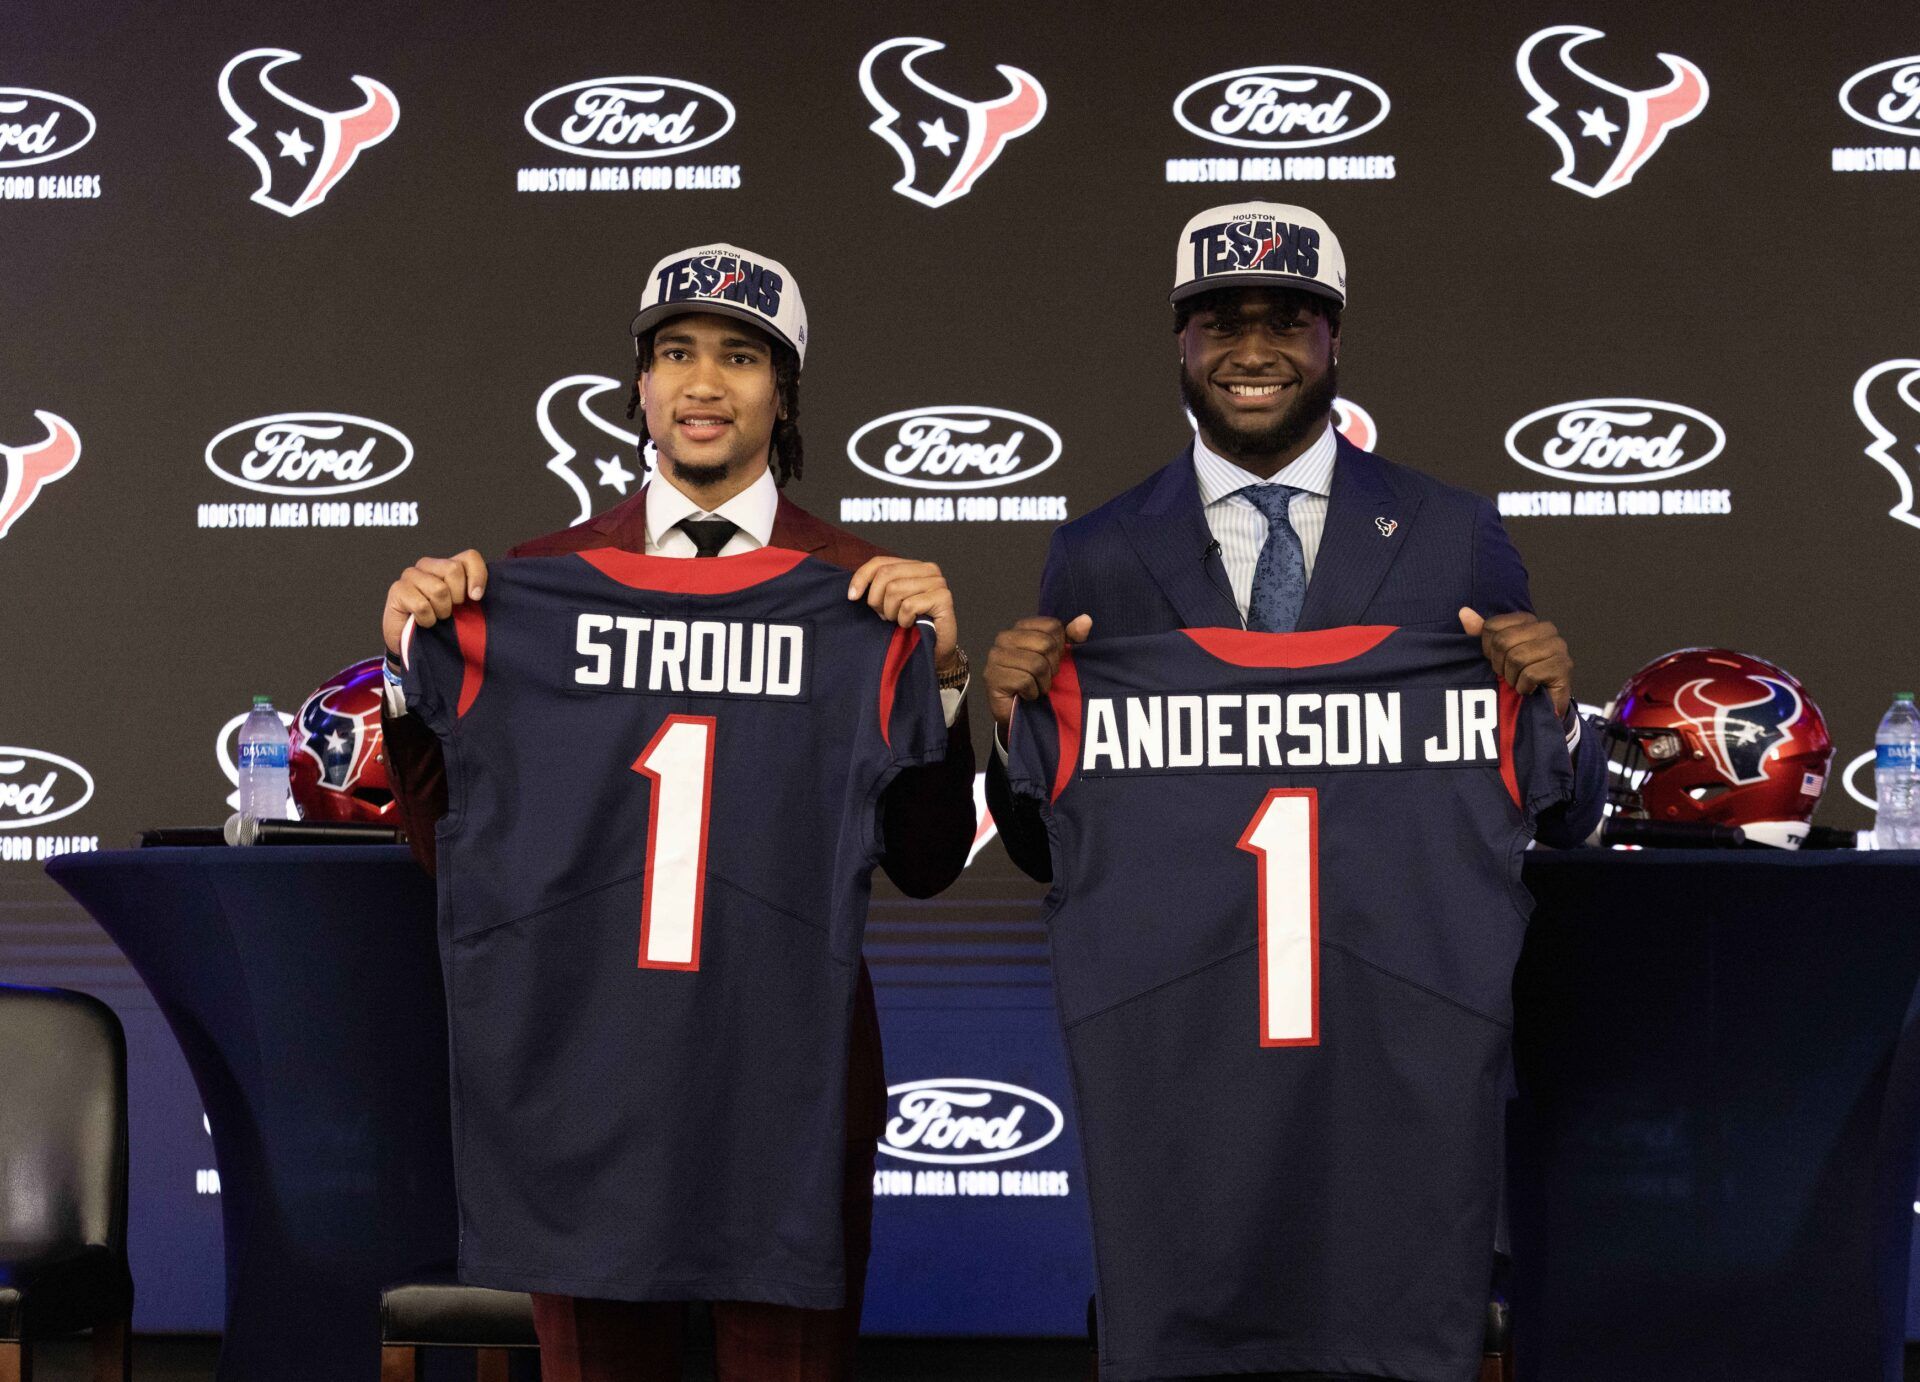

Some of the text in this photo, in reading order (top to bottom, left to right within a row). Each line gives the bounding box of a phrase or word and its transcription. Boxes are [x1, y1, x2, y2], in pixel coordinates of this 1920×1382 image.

[0, 99, 60, 153] rd
[561, 87, 699, 144] Ford
[1211, 76, 1352, 134] Ford
[38, 175, 101, 199] DEALERS
[517, 165, 741, 192] HOUSTON AREA FORD DEALERS
[1232, 213, 1276, 221] HOUSTON
[699, 250, 741, 259] HOUSTON
[241, 423, 377, 481] Ford
[885, 416, 1025, 475] Ford
[1543, 409, 1687, 468] Ford
[198, 502, 418, 528] HOUSTON AREA FORD DEALERS
[575, 613, 804, 697] STROUD
[1082, 688, 1499, 770] ANDERSON JR
[0, 759, 58, 815] rd
[0, 836, 32, 861] ORD
[630, 713, 718, 972] 1
[1235, 787, 1321, 1048] 1
[885, 1089, 1026, 1149] Ford
[874, 1170, 913, 1196] STON
